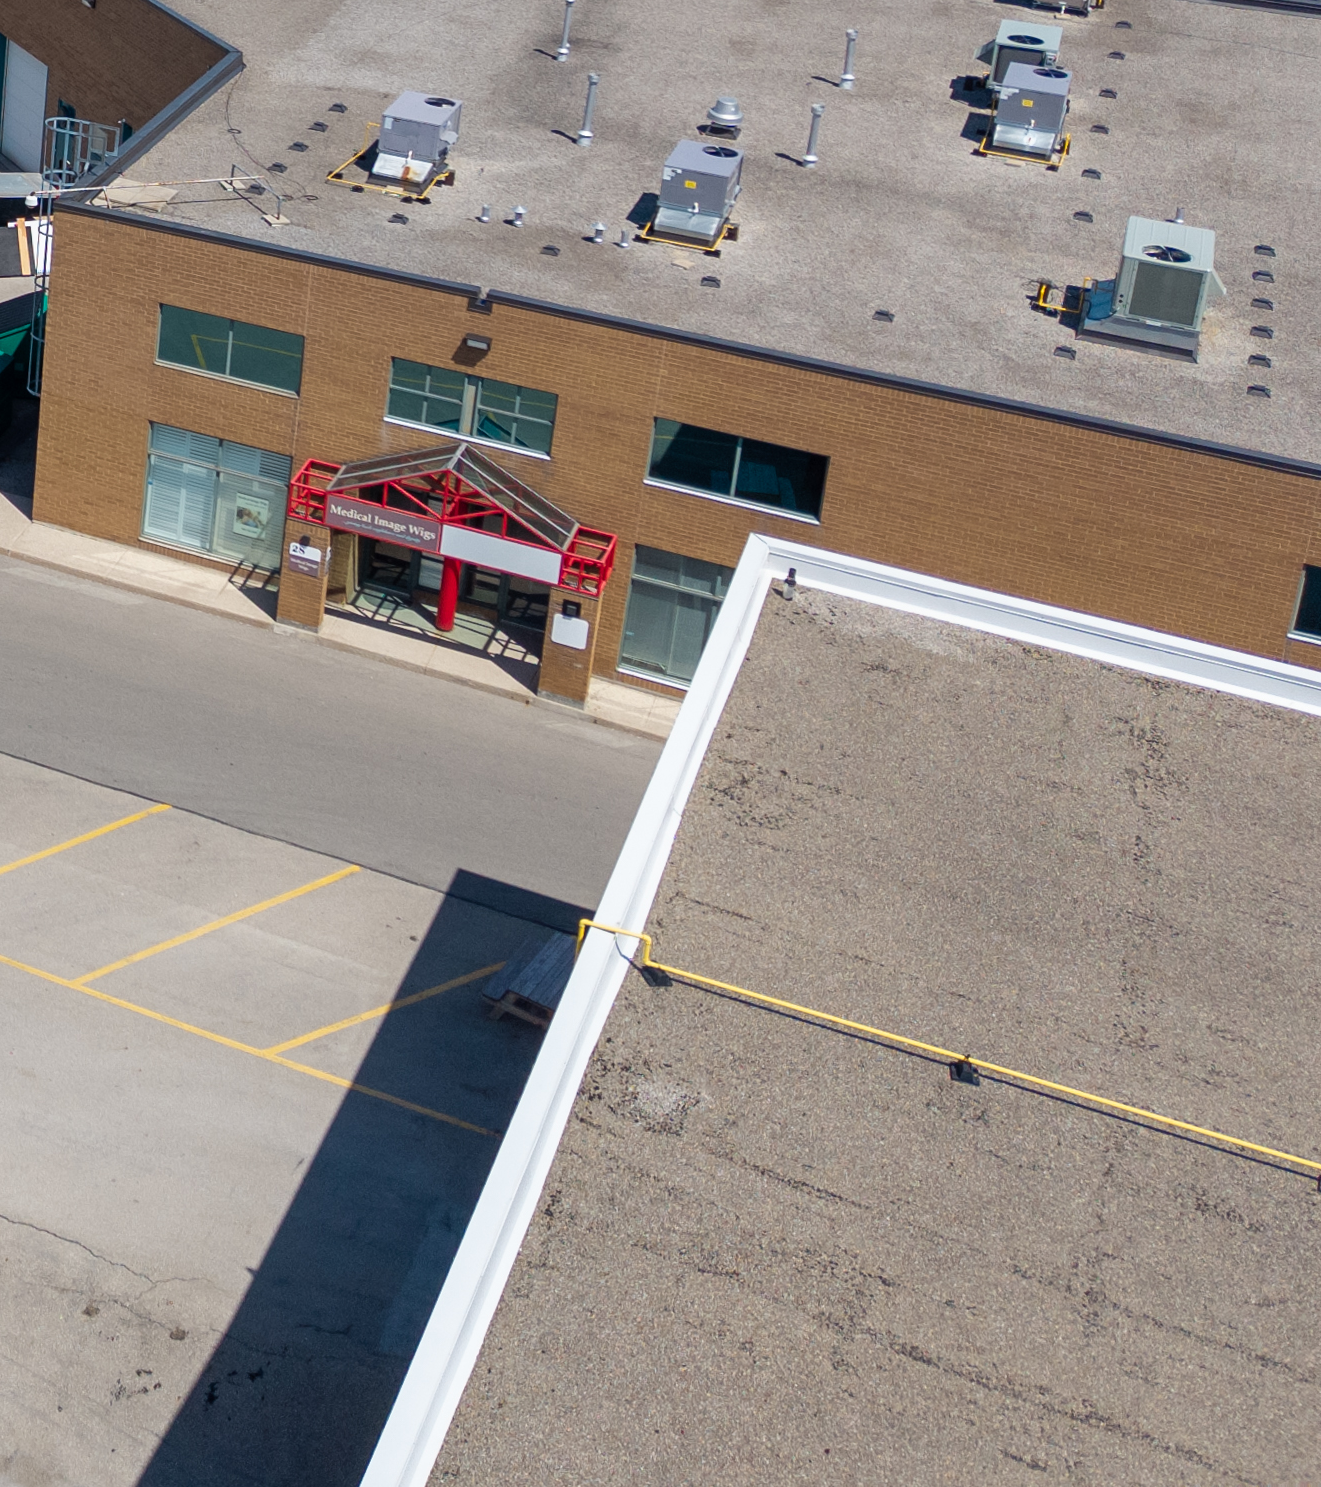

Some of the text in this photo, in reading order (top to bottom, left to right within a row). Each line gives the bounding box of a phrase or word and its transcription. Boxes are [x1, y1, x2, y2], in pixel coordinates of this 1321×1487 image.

[330, 504, 371, 523] Medical
[374, 514, 407, 532] Image
[408, 524, 436, 541] Wigs
